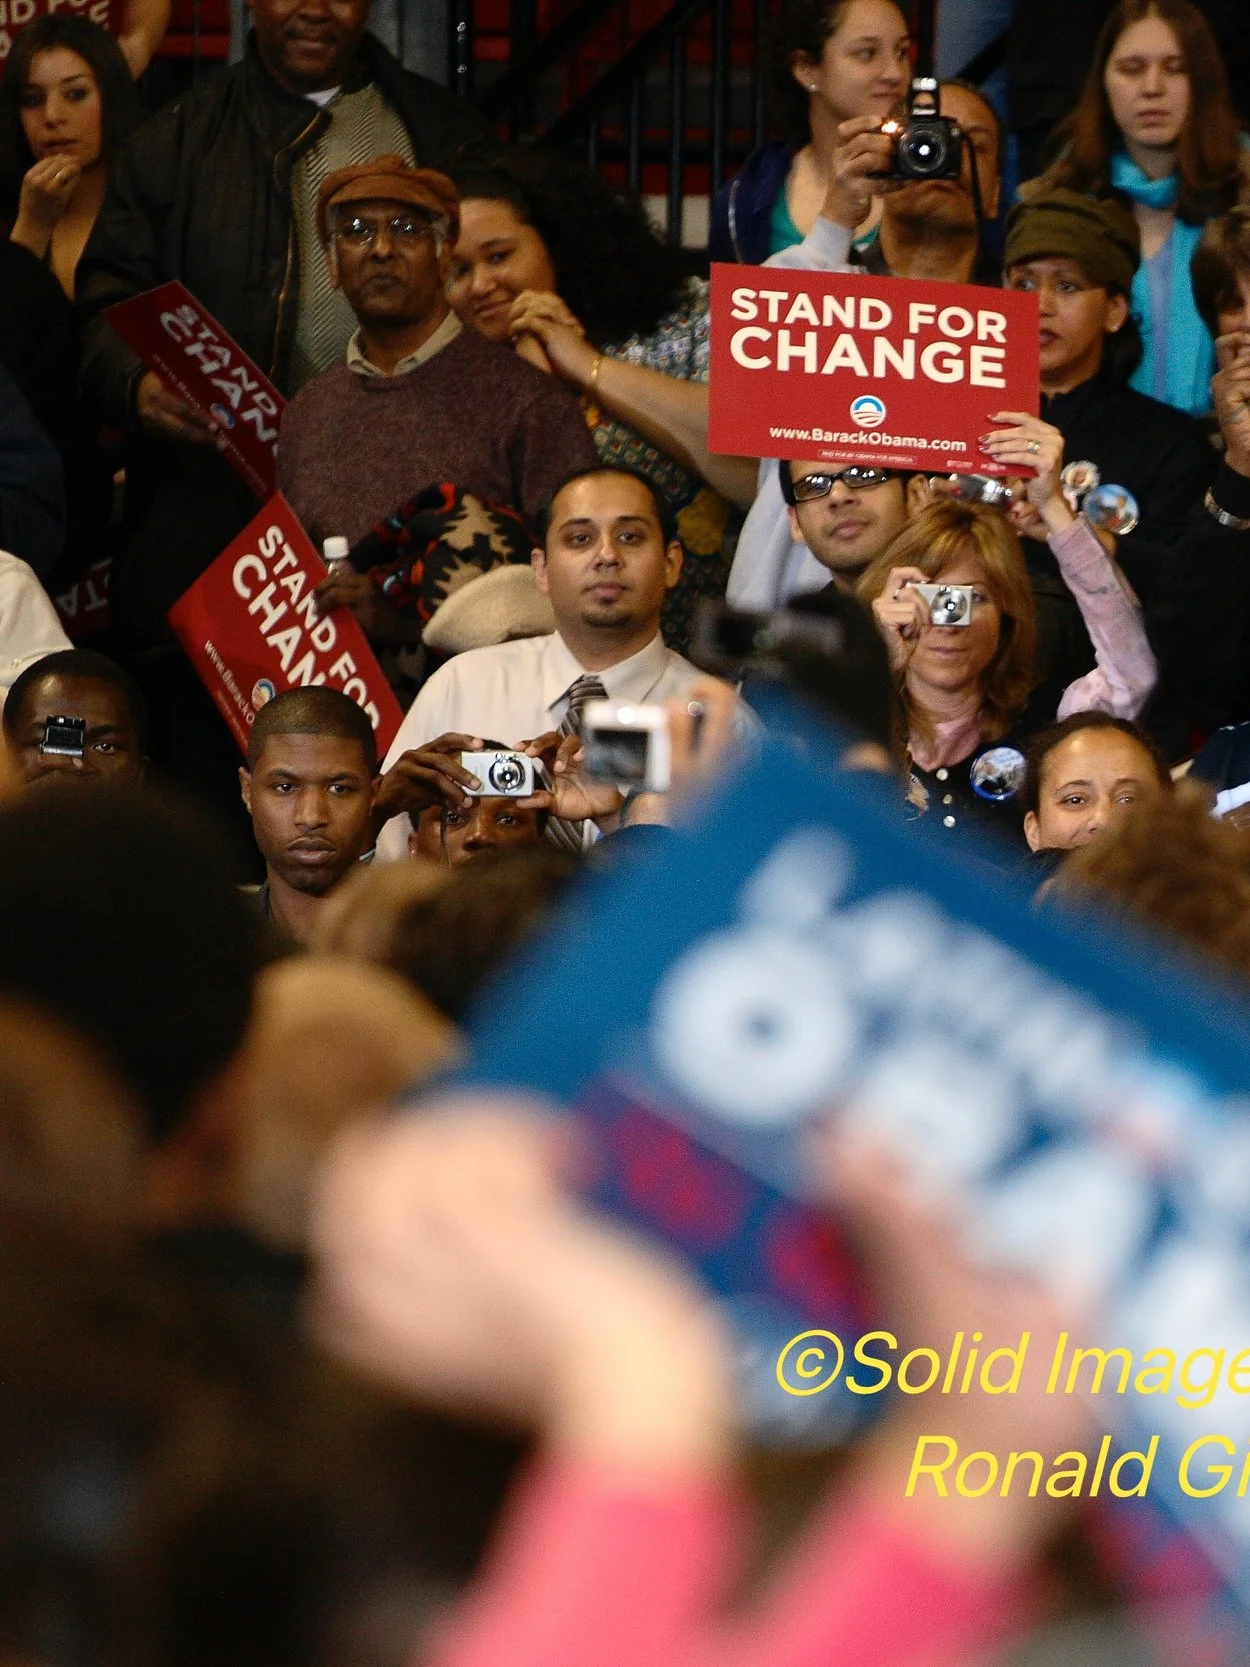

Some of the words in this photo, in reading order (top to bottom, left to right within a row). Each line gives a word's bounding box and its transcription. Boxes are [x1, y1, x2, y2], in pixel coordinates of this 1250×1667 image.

[730, 287, 893, 331] STAND
[908, 302, 1007, 344] FOR
[159, 311, 280, 458] CHAN
[729, 326, 1007, 389] CHANGE
[769, 426, 967, 453] www.BarackObama.com
[258, 525, 337, 653] STAND
